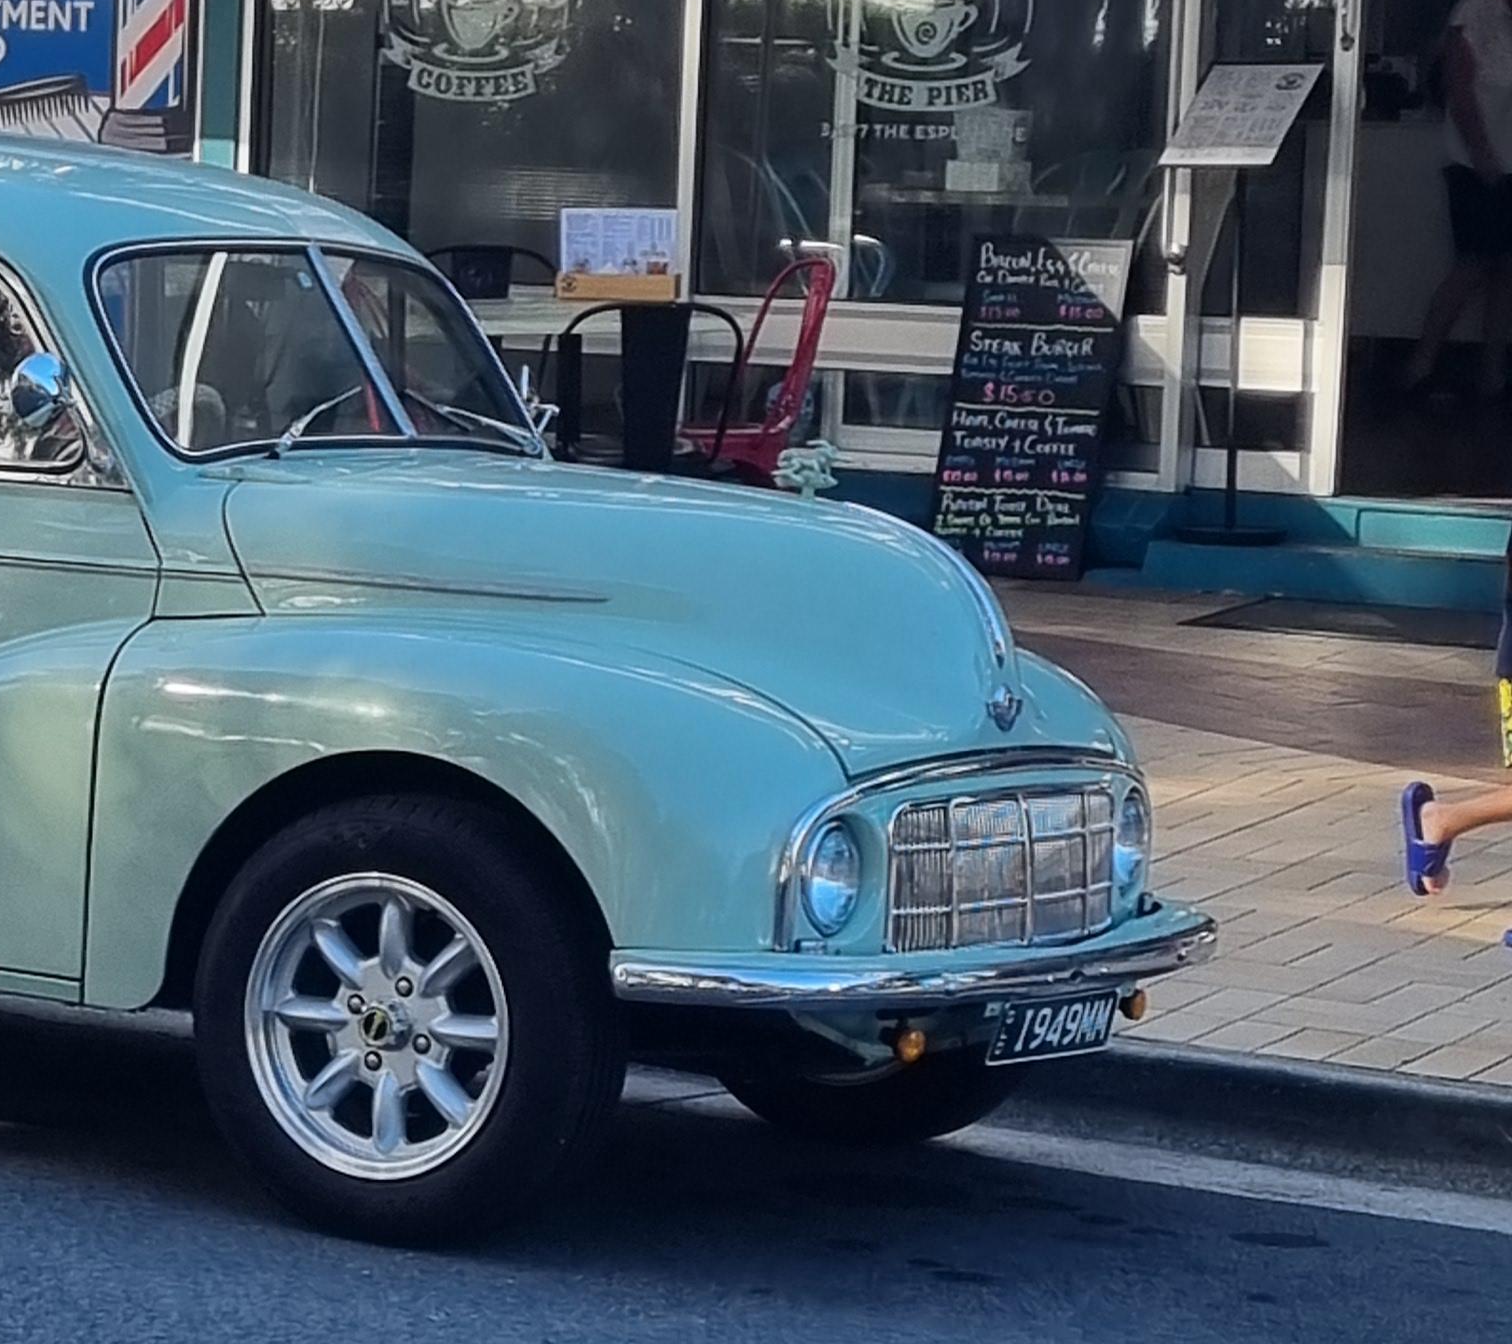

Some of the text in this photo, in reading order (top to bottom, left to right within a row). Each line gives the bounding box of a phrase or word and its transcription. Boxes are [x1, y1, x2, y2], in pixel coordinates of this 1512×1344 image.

[416, 66, 529, 95] COFFEE
[864, 78, 988, 107] THE PIER
[873, 124, 910, 139] THE
[970, 330, 1094, 359] STEAK BURGER
[1023, 435, 1077, 456] COFFEE
[1013, 998, 1114, 1052] 1949MM
